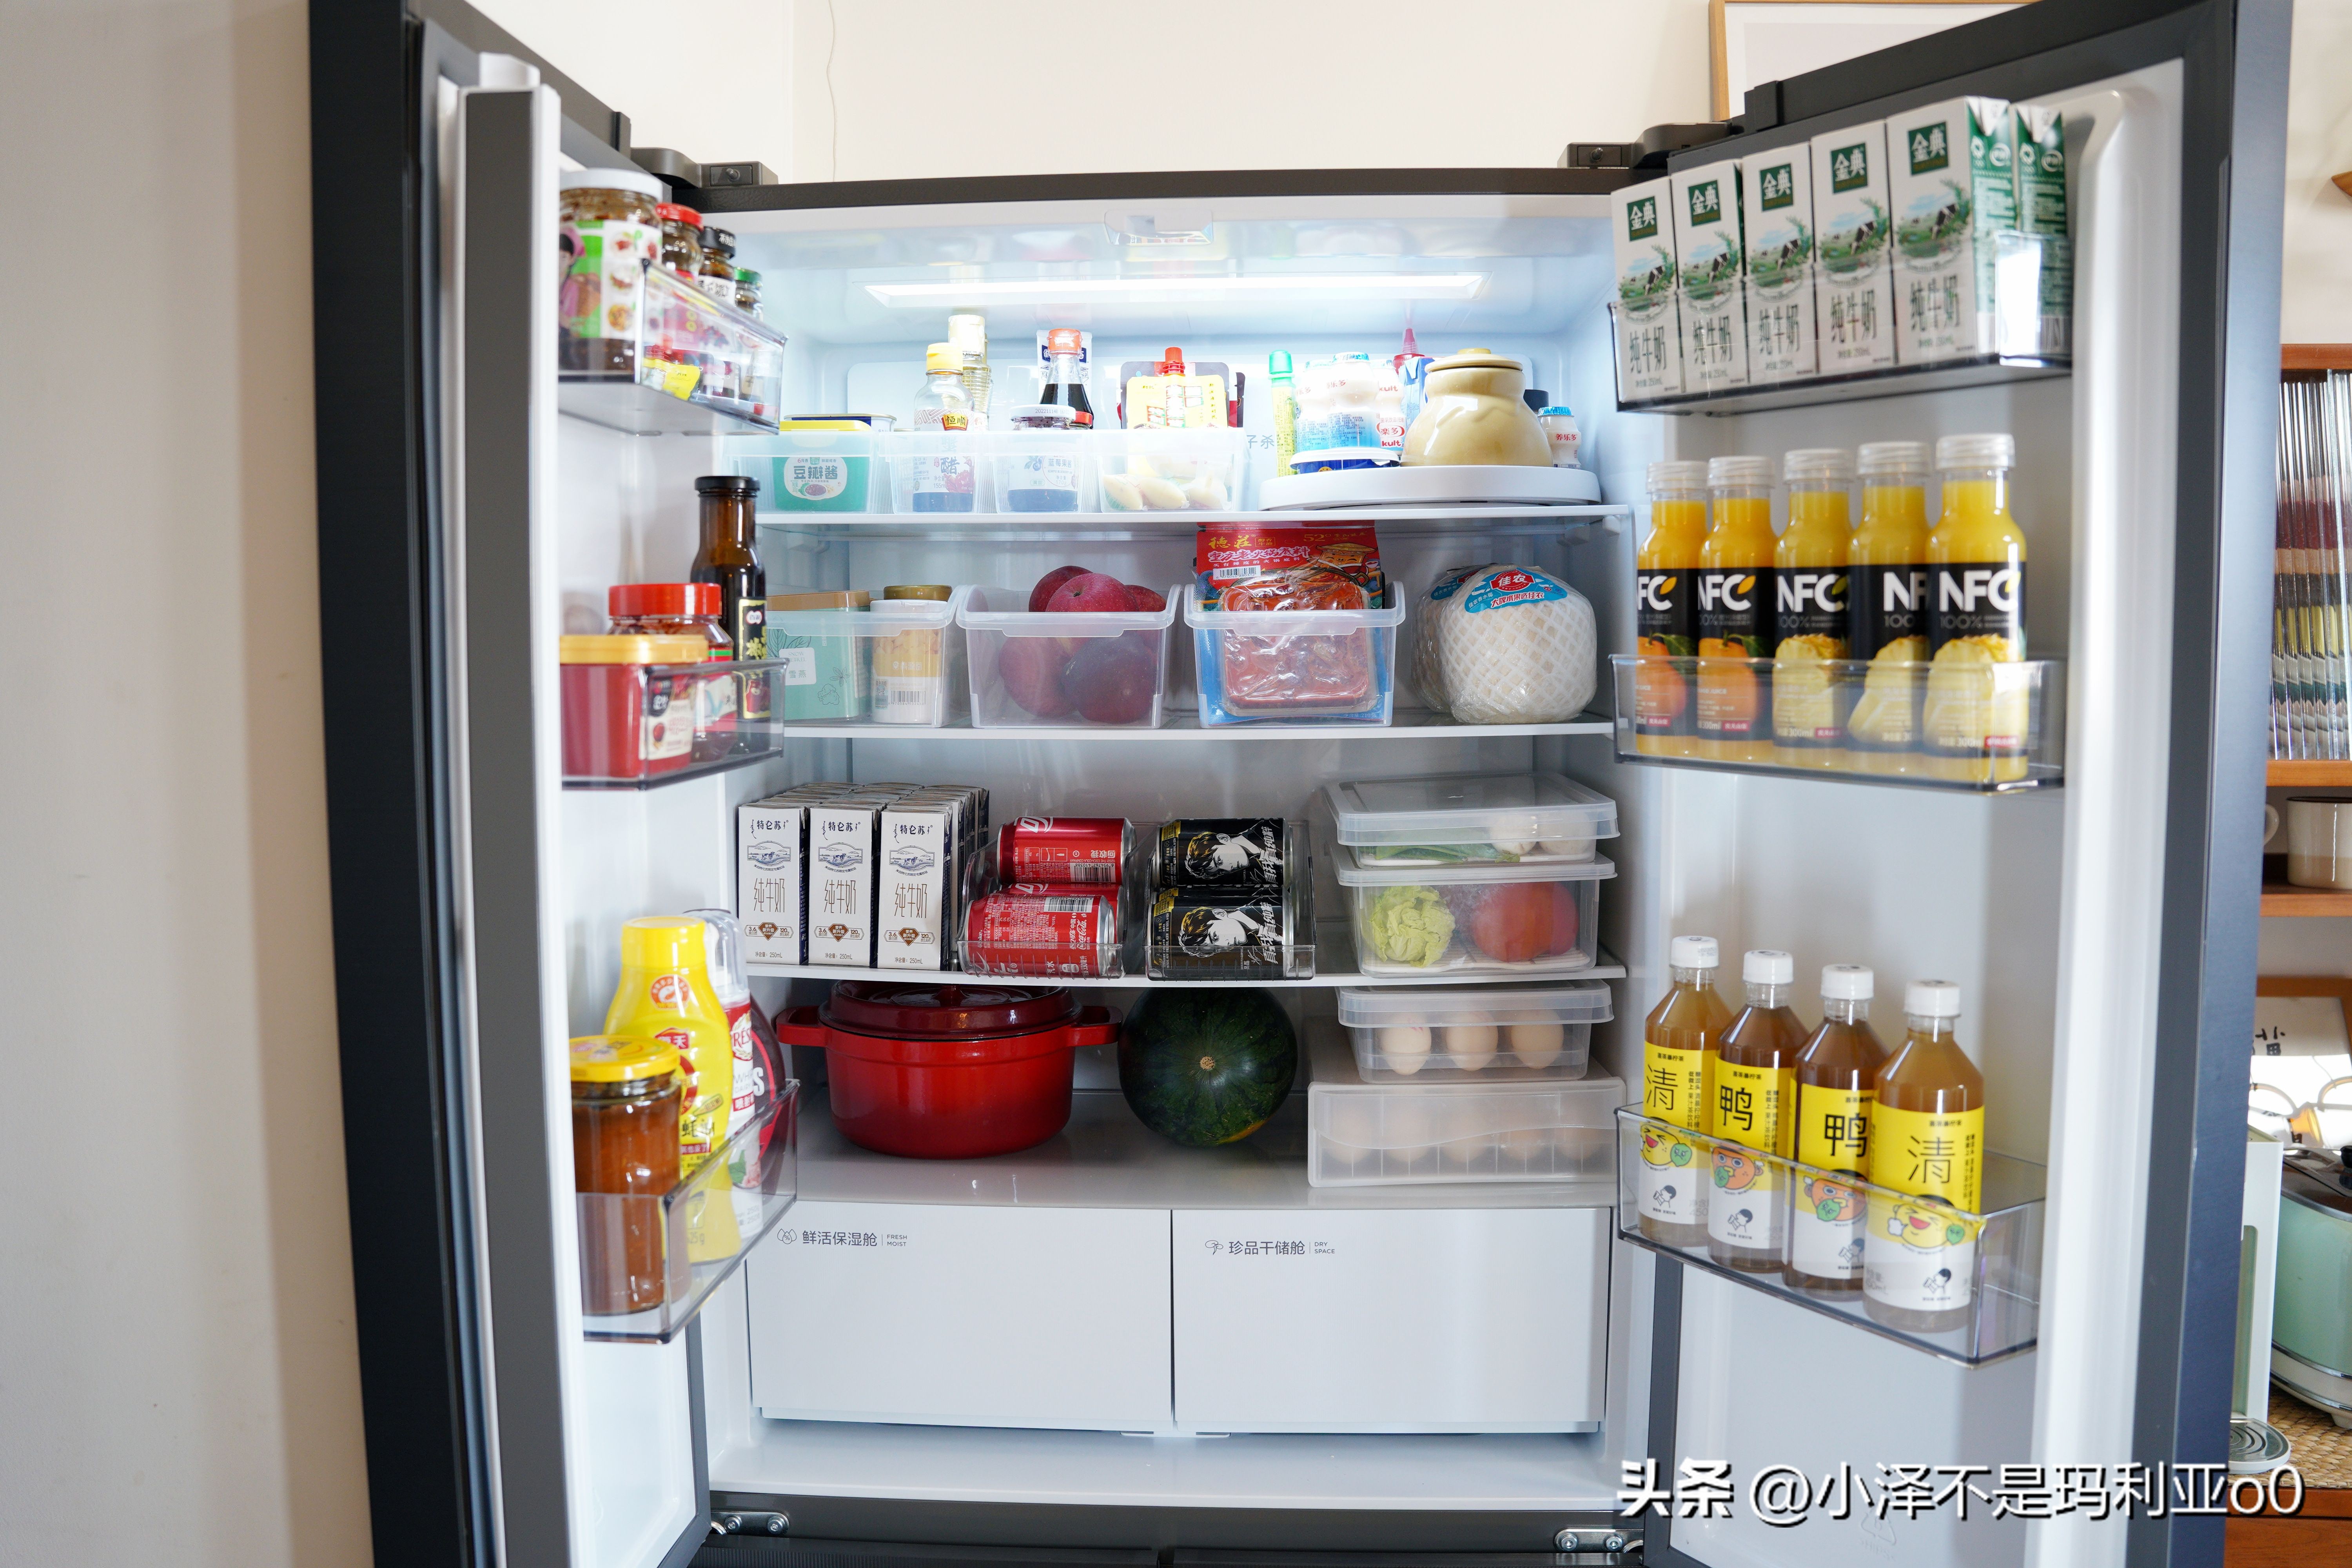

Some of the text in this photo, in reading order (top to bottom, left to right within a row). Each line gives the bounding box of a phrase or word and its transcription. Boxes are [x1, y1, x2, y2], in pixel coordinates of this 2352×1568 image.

[1911, 127, 1946, 163] 金典
[1834, 150, 1866, 182] 金典
[1762, 168, 1791, 199] 金典
[1629, 201, 1655, 230] 金典
[1691, 185, 1718, 215] 金典
[1693, 315, 1732, 365] 纯牛奶
[1759, 303, 1800, 355] 纯牛奶
[1629, 325, 1668, 374] 纯牛奶
[794, 465, 838, 479] 豆瓣酱
[940, 457, 960, 475] 醋
[1048, 458, 1072, 468] 蓝莓果酱
[1497, 573, 1528, 586] 佳农
[1637, 575, 1673, 611] FC
[1698, 574, 1752, 611] NFC
[1777, 573, 1844, 612] NFC
[1884, 571, 1929, 612] NF
[1939, 569, 2018, 612] NFC
[1468, 592, 1494, 608] 佳农香水椰
[1491, 592, 1544, 608] 大牌水果选佳农
[1884, 614, 1915, 628] 100
[789, 670, 806, 678] 雪燕
[757, 820, 781, 830] 特仑苏
[828, 821, 853, 832] 特仑苏
[900, 825, 925, 835] 特仑苏
[1091, 850, 1116, 858] 回收我
[1261, 826, 1278, 883] 真我真纯粹
[754, 878, 785, 913] 纯牛奶
[824, 879, 856, 915] 纯牛奶
[895, 883, 927, 918] 纯牛奶
[1259, 901, 1278, 964] 真我真纯粹
[1046, 960, 1056, 974] 汽水
[1646, 1063, 1678, 1110] 清
[1720, 1084, 1753, 1131] 鸭
[1824, 1112, 1867, 1158] 鸭
[1907, 1135, 1955, 1183] 清
[802, 1230, 877, 1246] 鲜活保湿舱
[1229, 1240, 1305, 1255] 珍品干储舱
